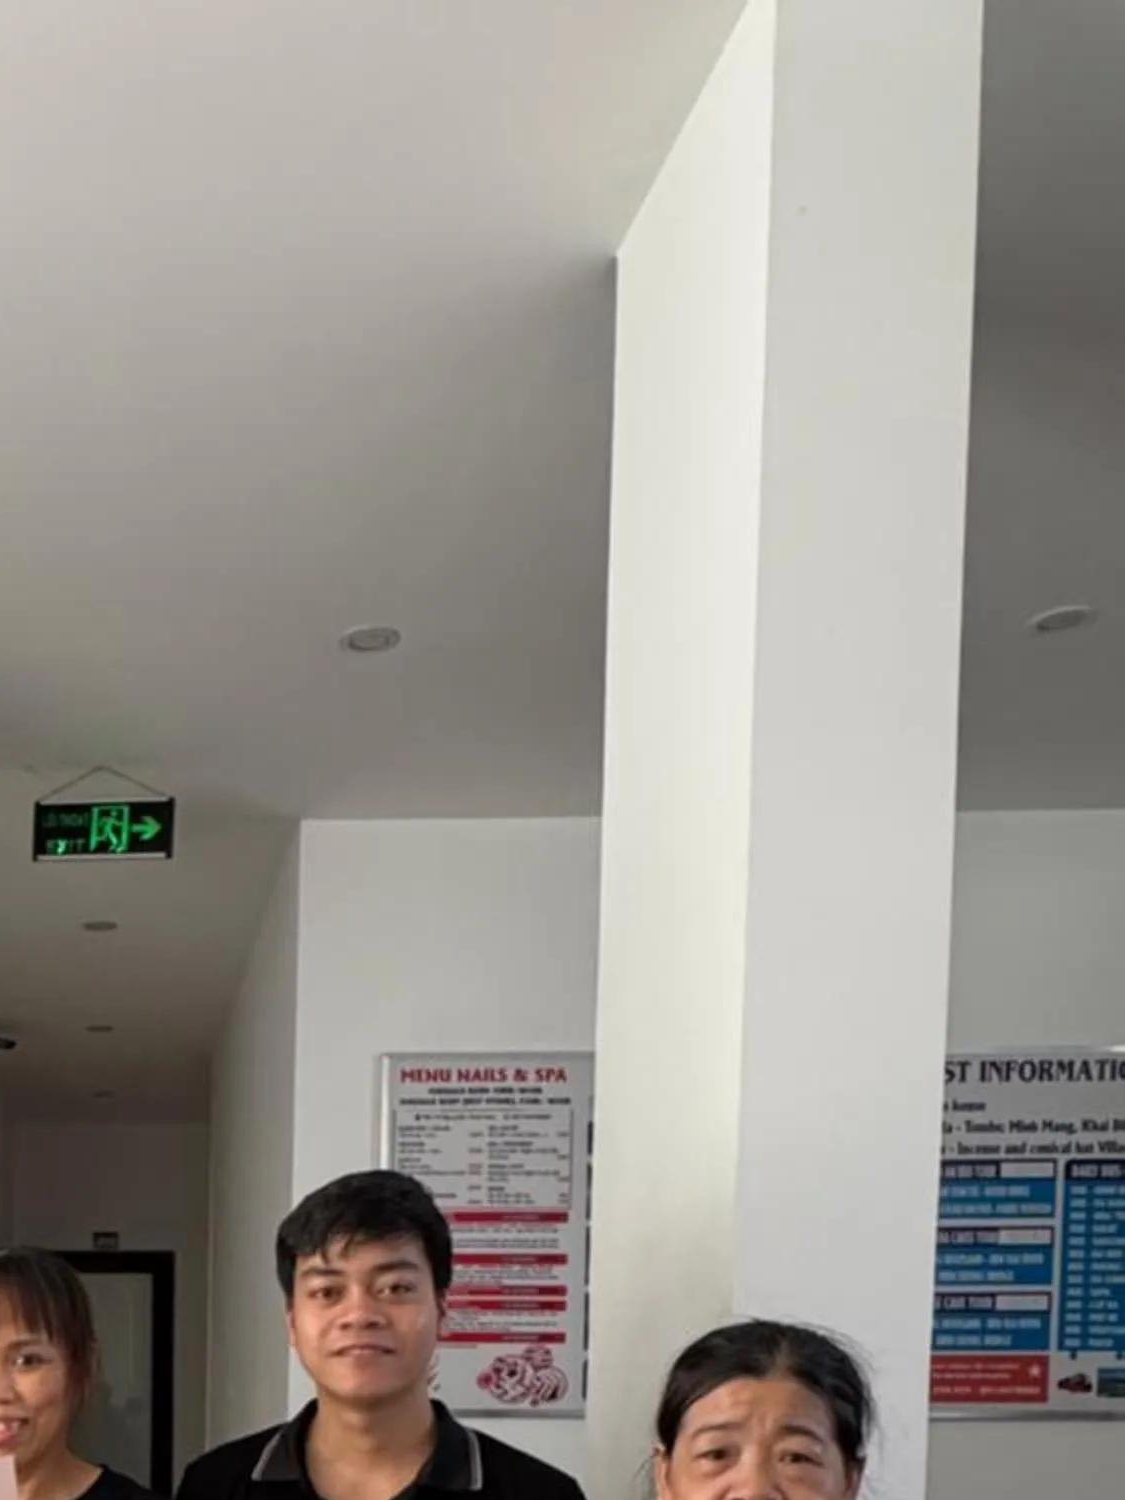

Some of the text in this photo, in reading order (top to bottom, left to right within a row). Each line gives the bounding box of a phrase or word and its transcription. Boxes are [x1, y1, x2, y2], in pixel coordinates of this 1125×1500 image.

[45, 838, 86, 854] EXIT
[400, 1068, 452, 1083] MENU
[457, 1068, 507, 1083] NAILS
[534, 1067, 568, 1083] SPA
[944, 1059, 972, 1084] ST
